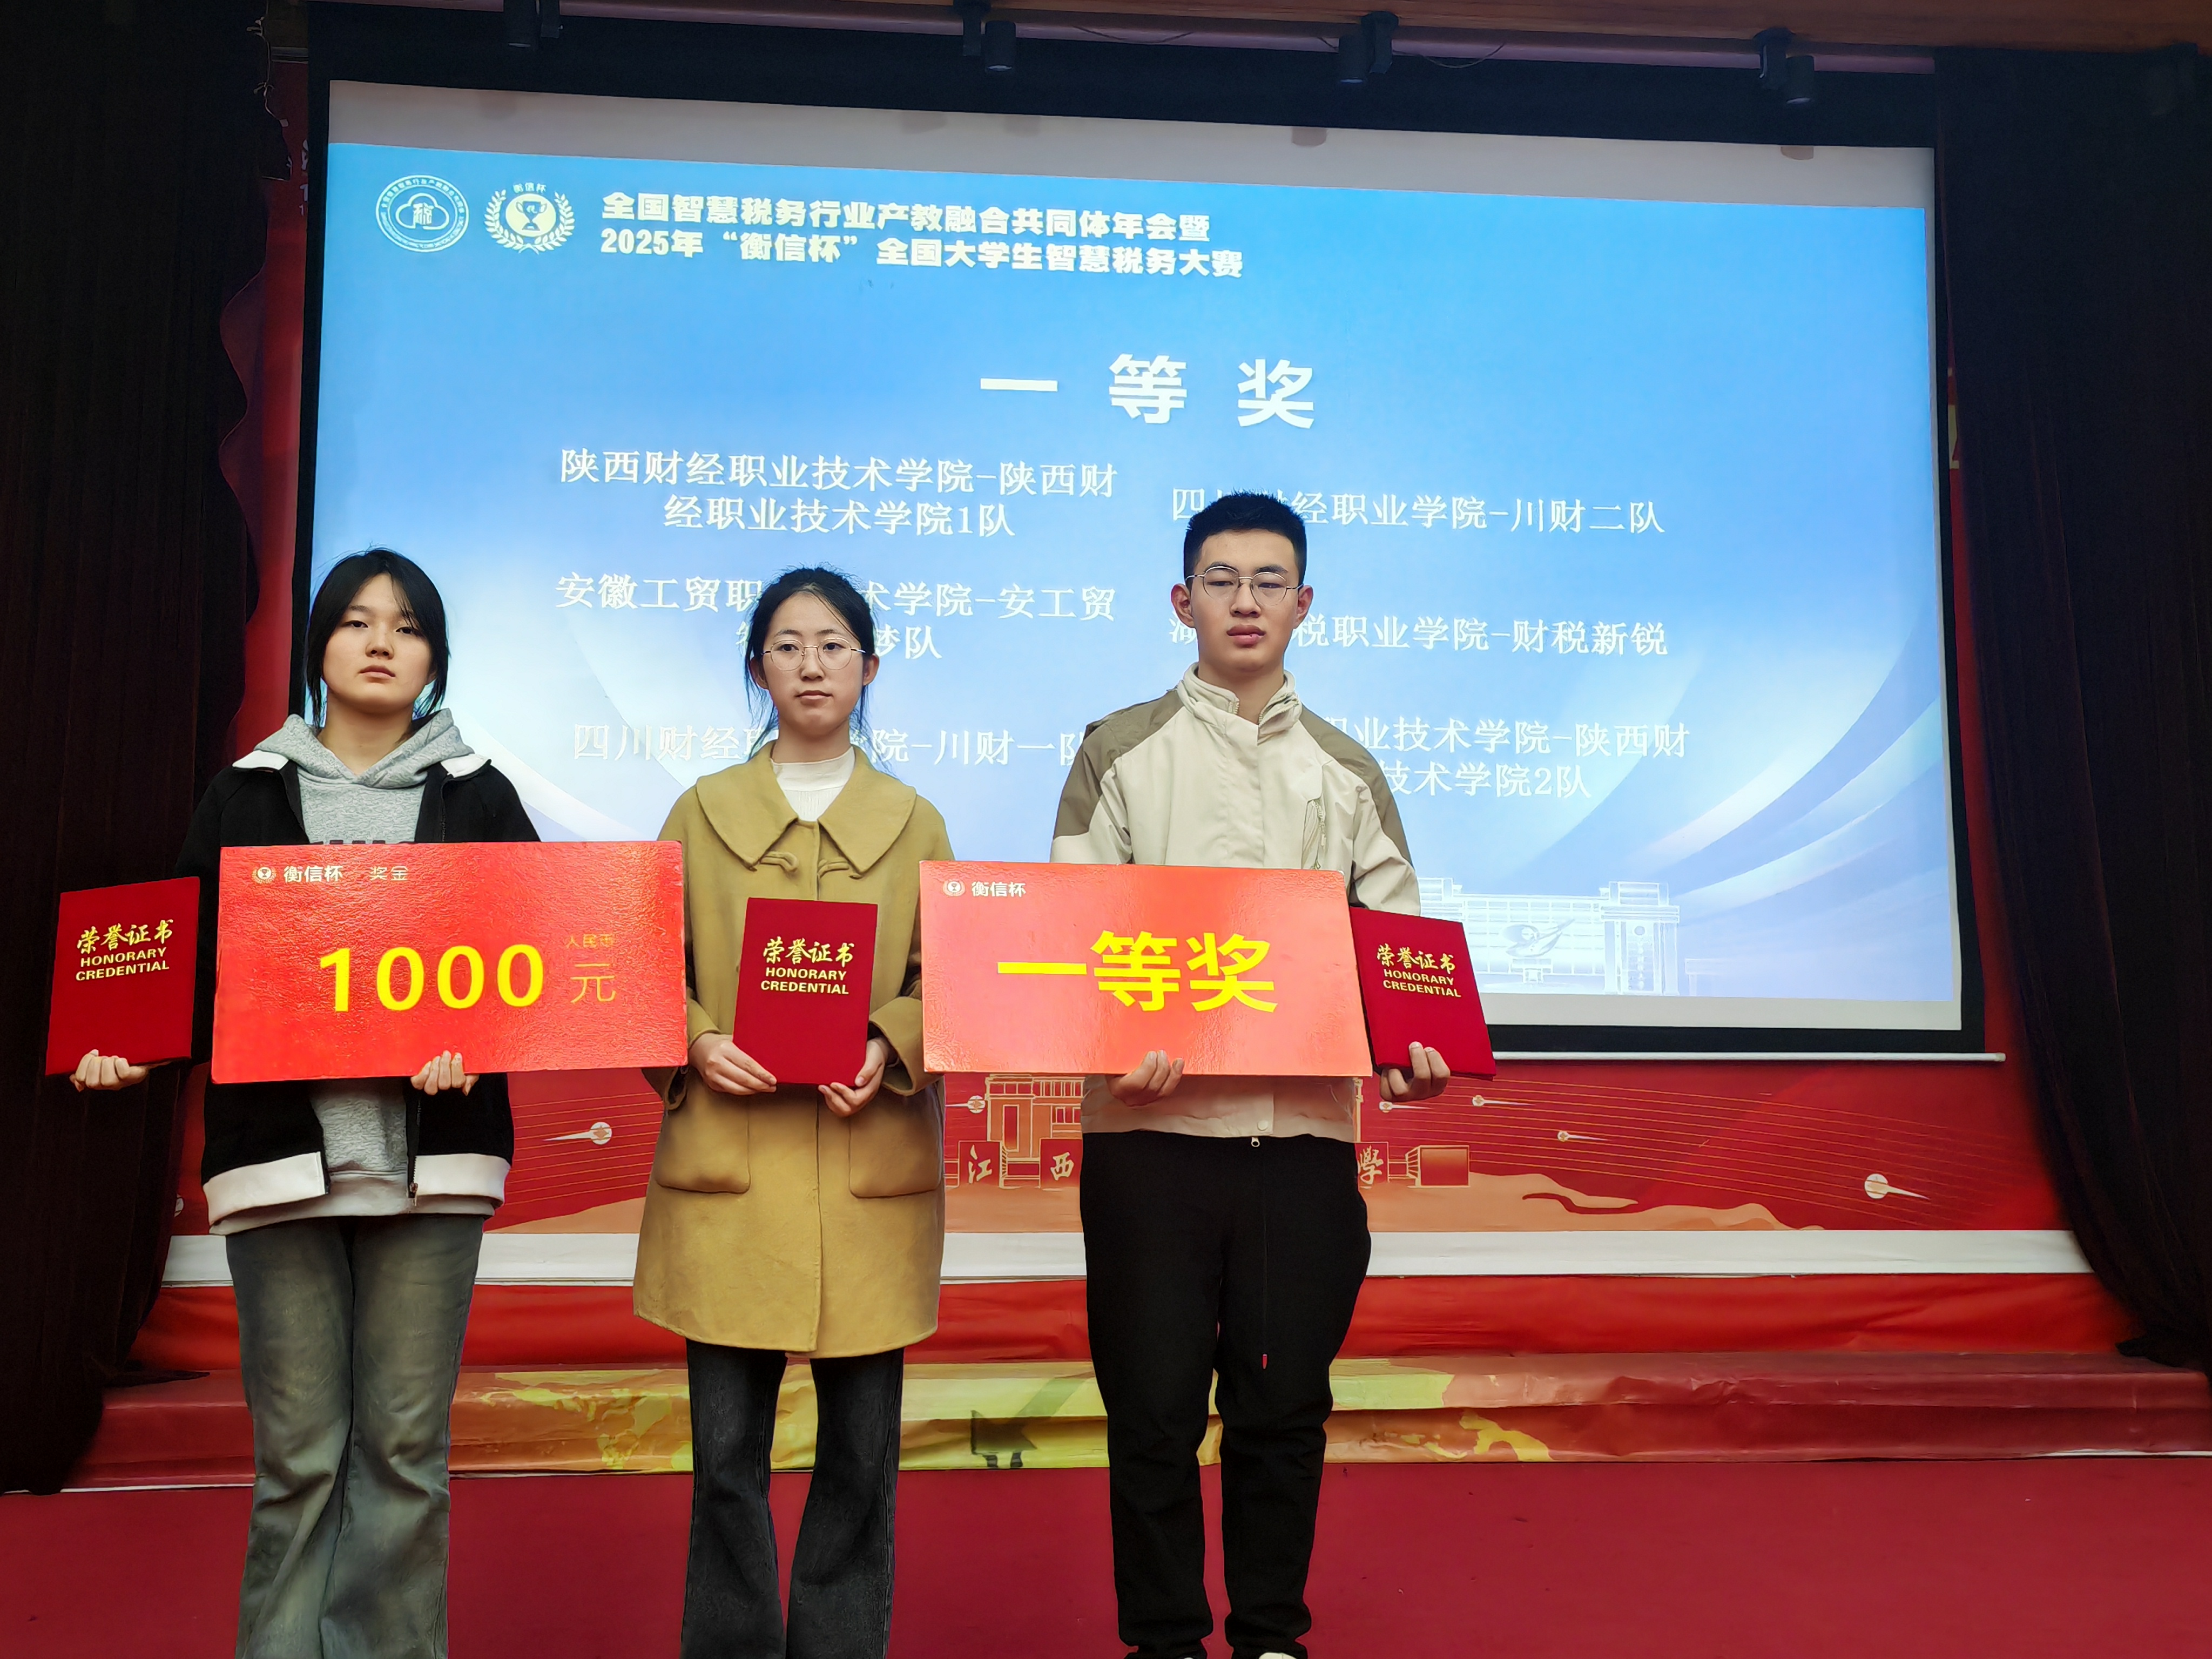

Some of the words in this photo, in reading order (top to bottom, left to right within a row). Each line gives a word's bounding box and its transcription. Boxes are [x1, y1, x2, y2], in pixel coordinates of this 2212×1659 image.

[602, 192, 1210, 242] 全国智慧税务行业产教融合共同体年会暨
[664, 494, 1015, 538] 经职业技术学院1队
[284, 865, 343, 883] 衡信杯
[369, 866, 408, 881] 奖金
[972, 881, 1027, 898] 衡信杯
[77, 919, 173, 954] 荣誉证书
[80, 947, 167, 968] HONORARY
[763, 938, 855, 967] 荣誉证书
[1376, 943, 1456, 974] 荣誉证书
[76, 960, 170, 981] CREDENTIAL
[320, 944, 543, 1011] 1000
[570, 962, 616, 1003] 元
[765, 967, 847, 982] HONORARY
[997, 930, 1278, 1013] 一等奖
[1383, 969, 1454, 986] HONORARY
[760, 981, 849, 995] CREDENTIAL
[1382, 980, 1461, 998] CREDENTIAL
